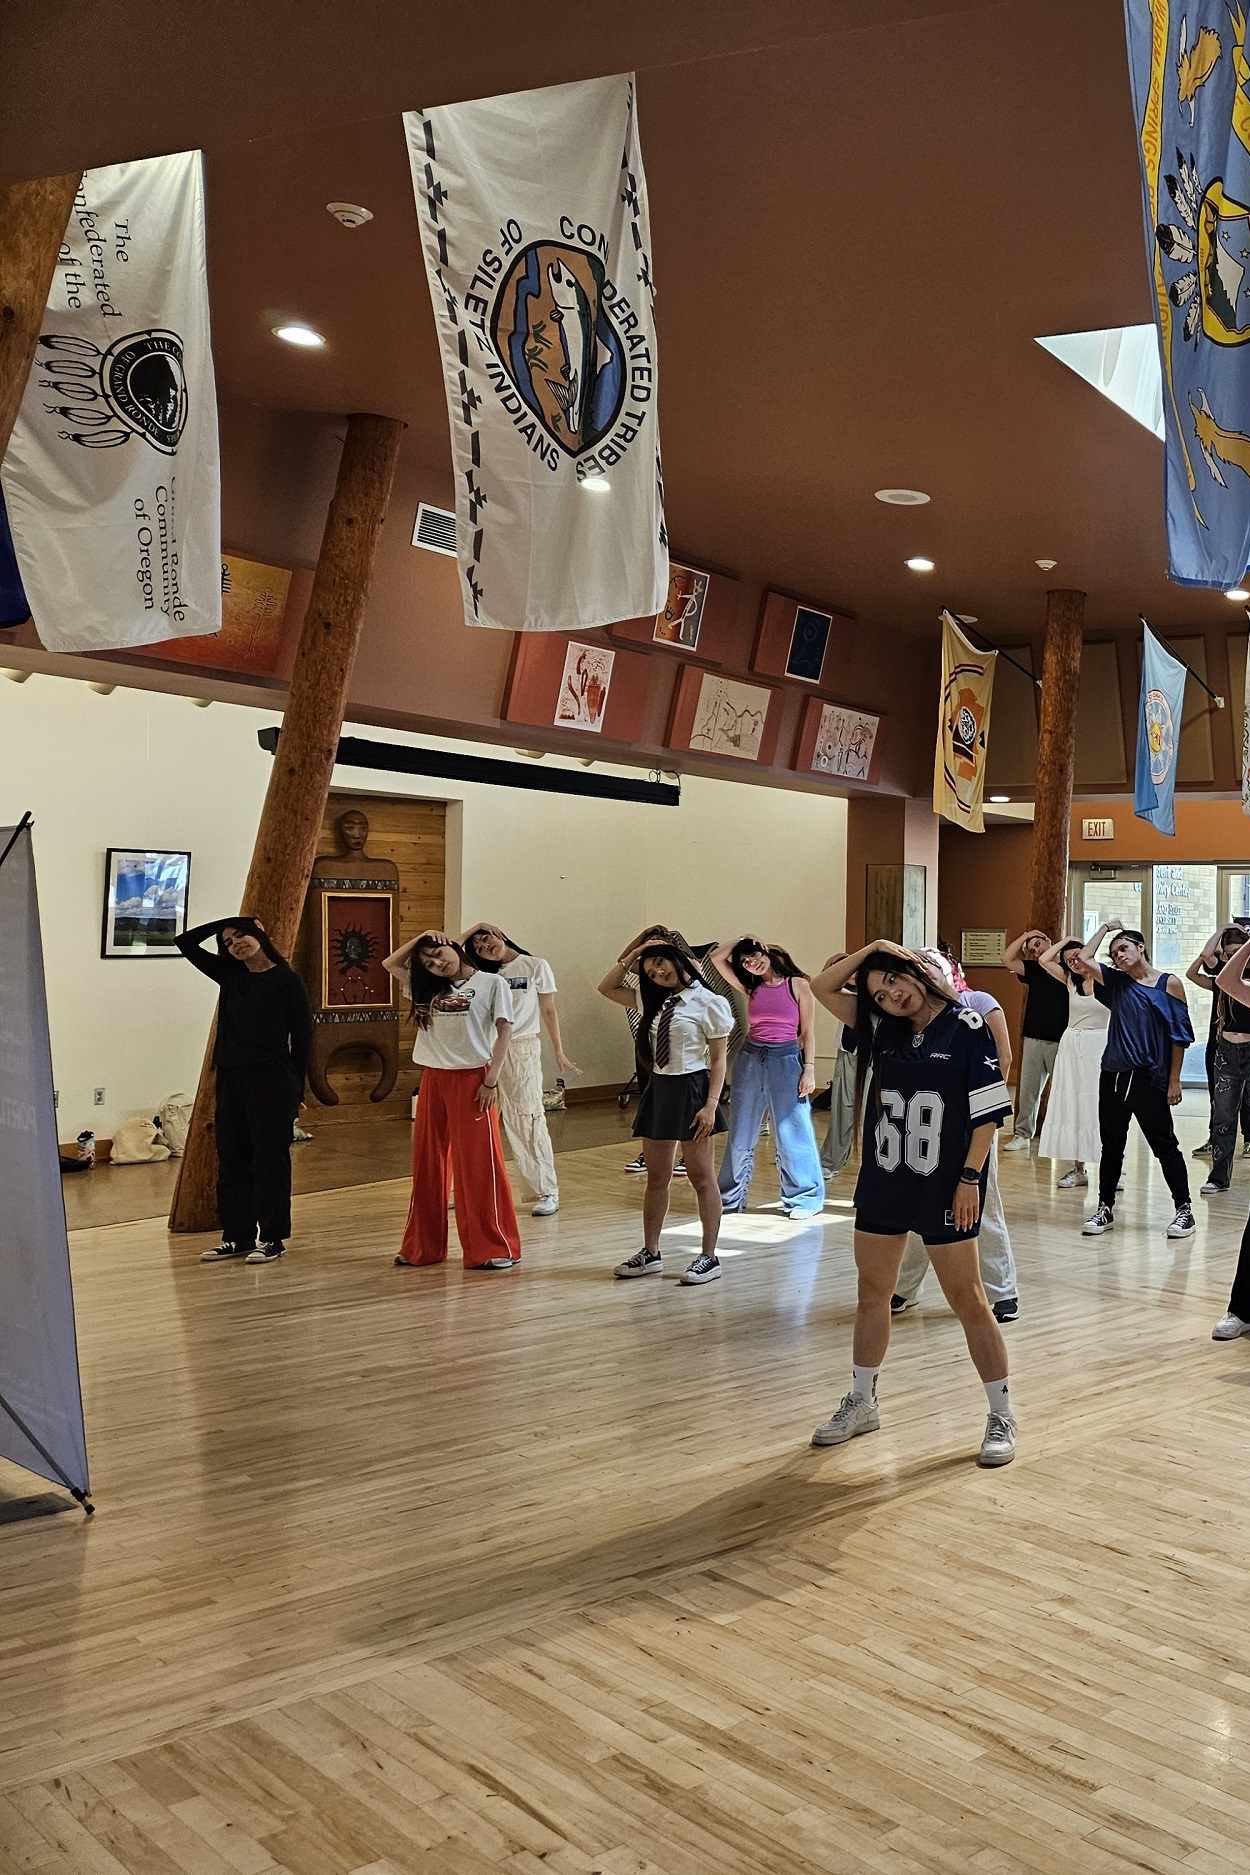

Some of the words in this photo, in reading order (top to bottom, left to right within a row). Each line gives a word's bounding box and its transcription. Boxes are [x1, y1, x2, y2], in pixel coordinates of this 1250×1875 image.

[59, 243, 83, 266] of
[73, 170, 123, 318] onfederated
[114, 218, 132, 263] The
[500, 218, 523, 257] OF
[65, 272, 87, 309] the
[464, 248, 503, 357] SILETZ
[121, 351, 136, 365] OF
[144, 340, 170, 351] THE
[125, 404, 159, 436] RONDE
[486, 362, 560, 472] INDIANS
[576, 410, 646, 483] TRIBES
[134, 498, 151, 521] of
[136, 526, 154, 611] Oregon
[1087, 821, 1106, 838] EXIT
[874, 1088, 945, 1177] 68
